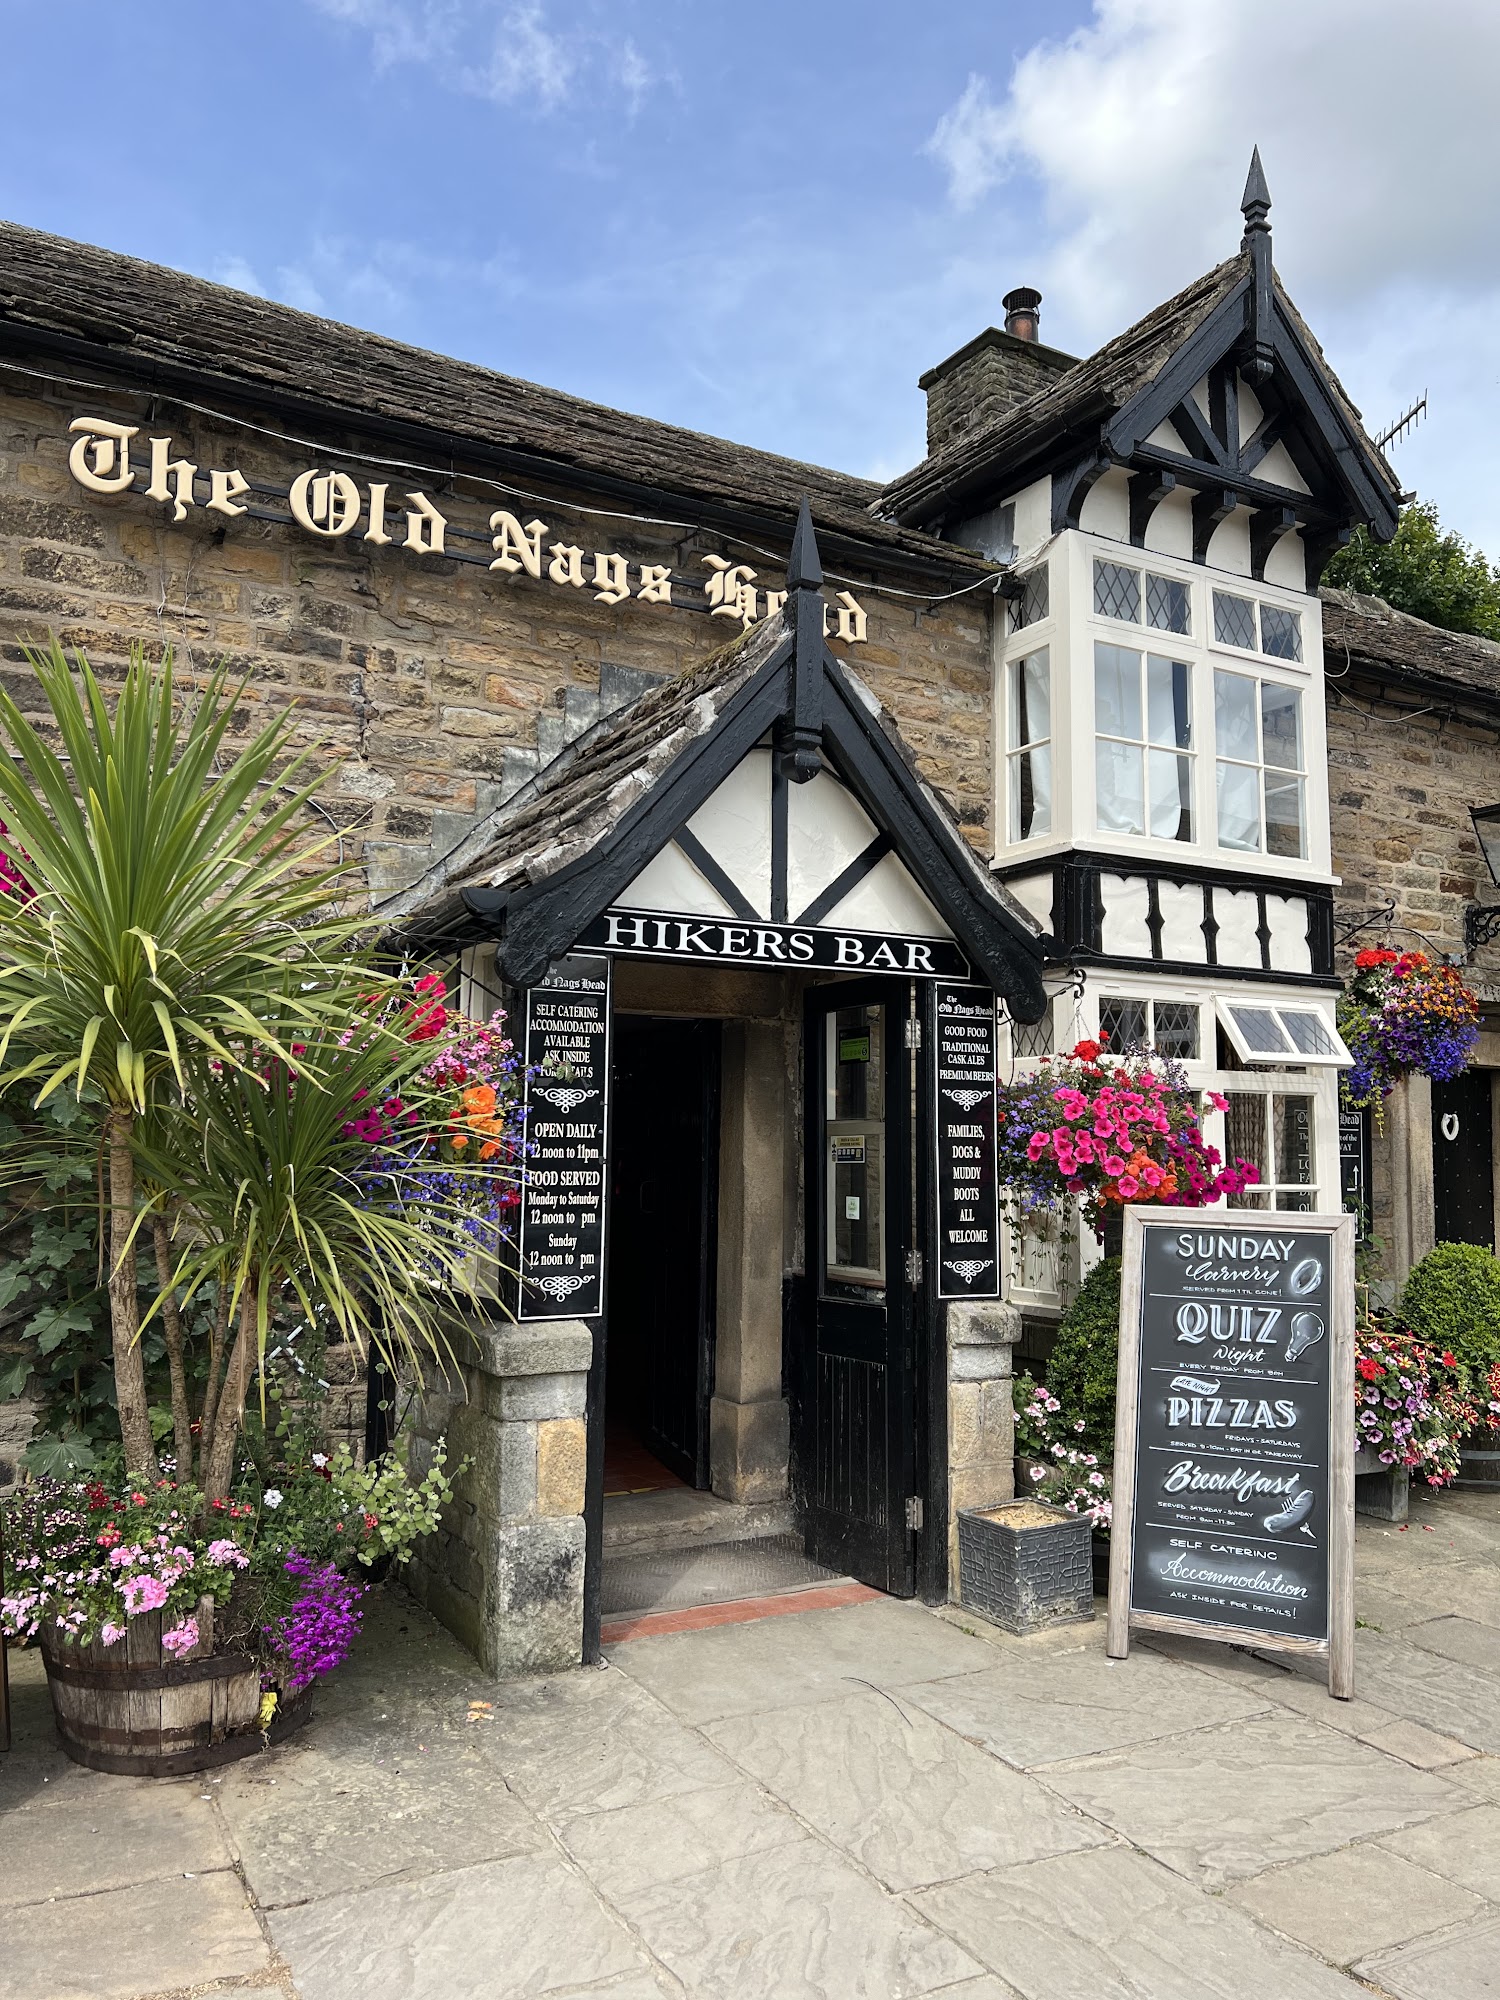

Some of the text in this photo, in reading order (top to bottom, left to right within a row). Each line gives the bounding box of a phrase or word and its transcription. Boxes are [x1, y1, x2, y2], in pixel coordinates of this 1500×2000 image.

[68, 416, 868, 643] The Old Nags Hed
[604, 915, 936, 971] HIKERS BAR
[551, 976, 581, 990] Nags
[581, 978, 606, 991] Head
[946, 995, 958, 1003] The
[536, 1003, 599, 1018] SELF CATERING
[938, 1003, 993, 1016] Old Nags Head
[530, 1019, 605, 1033] ACCOMMODATION
[944, 1025, 988, 1038] GOOD FOOD
[544, 1035, 591, 1048] AVAILABLE
[941, 1041, 991, 1053] TRADITIONAL
[544, 1049, 591, 1063] ASK INSIDE
[947, 1054, 985, 1065] CASK ALES
[939, 1069, 995, 1081] PREMIUM BEERS
[1339, 1112, 1360, 1126] Head
[534, 1123, 597, 1138] OPEN DAILY
[947, 1124, 985, 1141] FAMILIES,
[542, 1147, 564, 1158] noon
[566, 1145, 575, 1158] to
[576, 1144, 599, 1163] 11pm
[952, 1145, 981, 1158] DOGS &
[529, 1170, 600, 1186] FOOD SERVED
[953, 1167, 981, 1179] MUDDY
[528, 1191, 599, 1209] Monday to Saturday
[954, 1187, 979, 1200] BOOTS
[530, 1209, 596, 1228] 12 noon to pm
[959, 1208, 975, 1221] ALL
[548, 1233, 577, 1250] Sunday
[949, 1229, 988, 1243] WELCOME
[1177, 1234, 1295, 1261] SUNDAY
[529, 1251, 595, 1269] 12 noon to pm
[1185, 1261, 1280, 1286] Carvery
[1255, 1288, 1282, 1297] GONE!
[1176, 1302, 1283, 1344] QUIZ
[1213, 1345, 1266, 1366] Night
[1175, 1378, 1216, 1393] LATE NIGHT
[1168, 1397, 1297, 1429] PIZZAS
[1225, 1434, 1254, 1443] FRIDAYS
[1260, 1438, 1301, 1448] SATURDAYS
[1264, 1450, 1303, 1459] TAKEAWAY
[1164, 1460, 1300, 1502] Breakfast
[1157, 1501, 1186, 1509] SERVED
[1189, 1505, 1222, 1514] SATURDAY
[1227, 1509, 1254, 1518] SUNDAY
[1169, 1538, 1278, 1560] SELF CATERING
[1160, 1552, 1309, 1598] Accommodation
[1170, 1591, 1297, 1619] ASK INSIDE FOR DETAILS!
